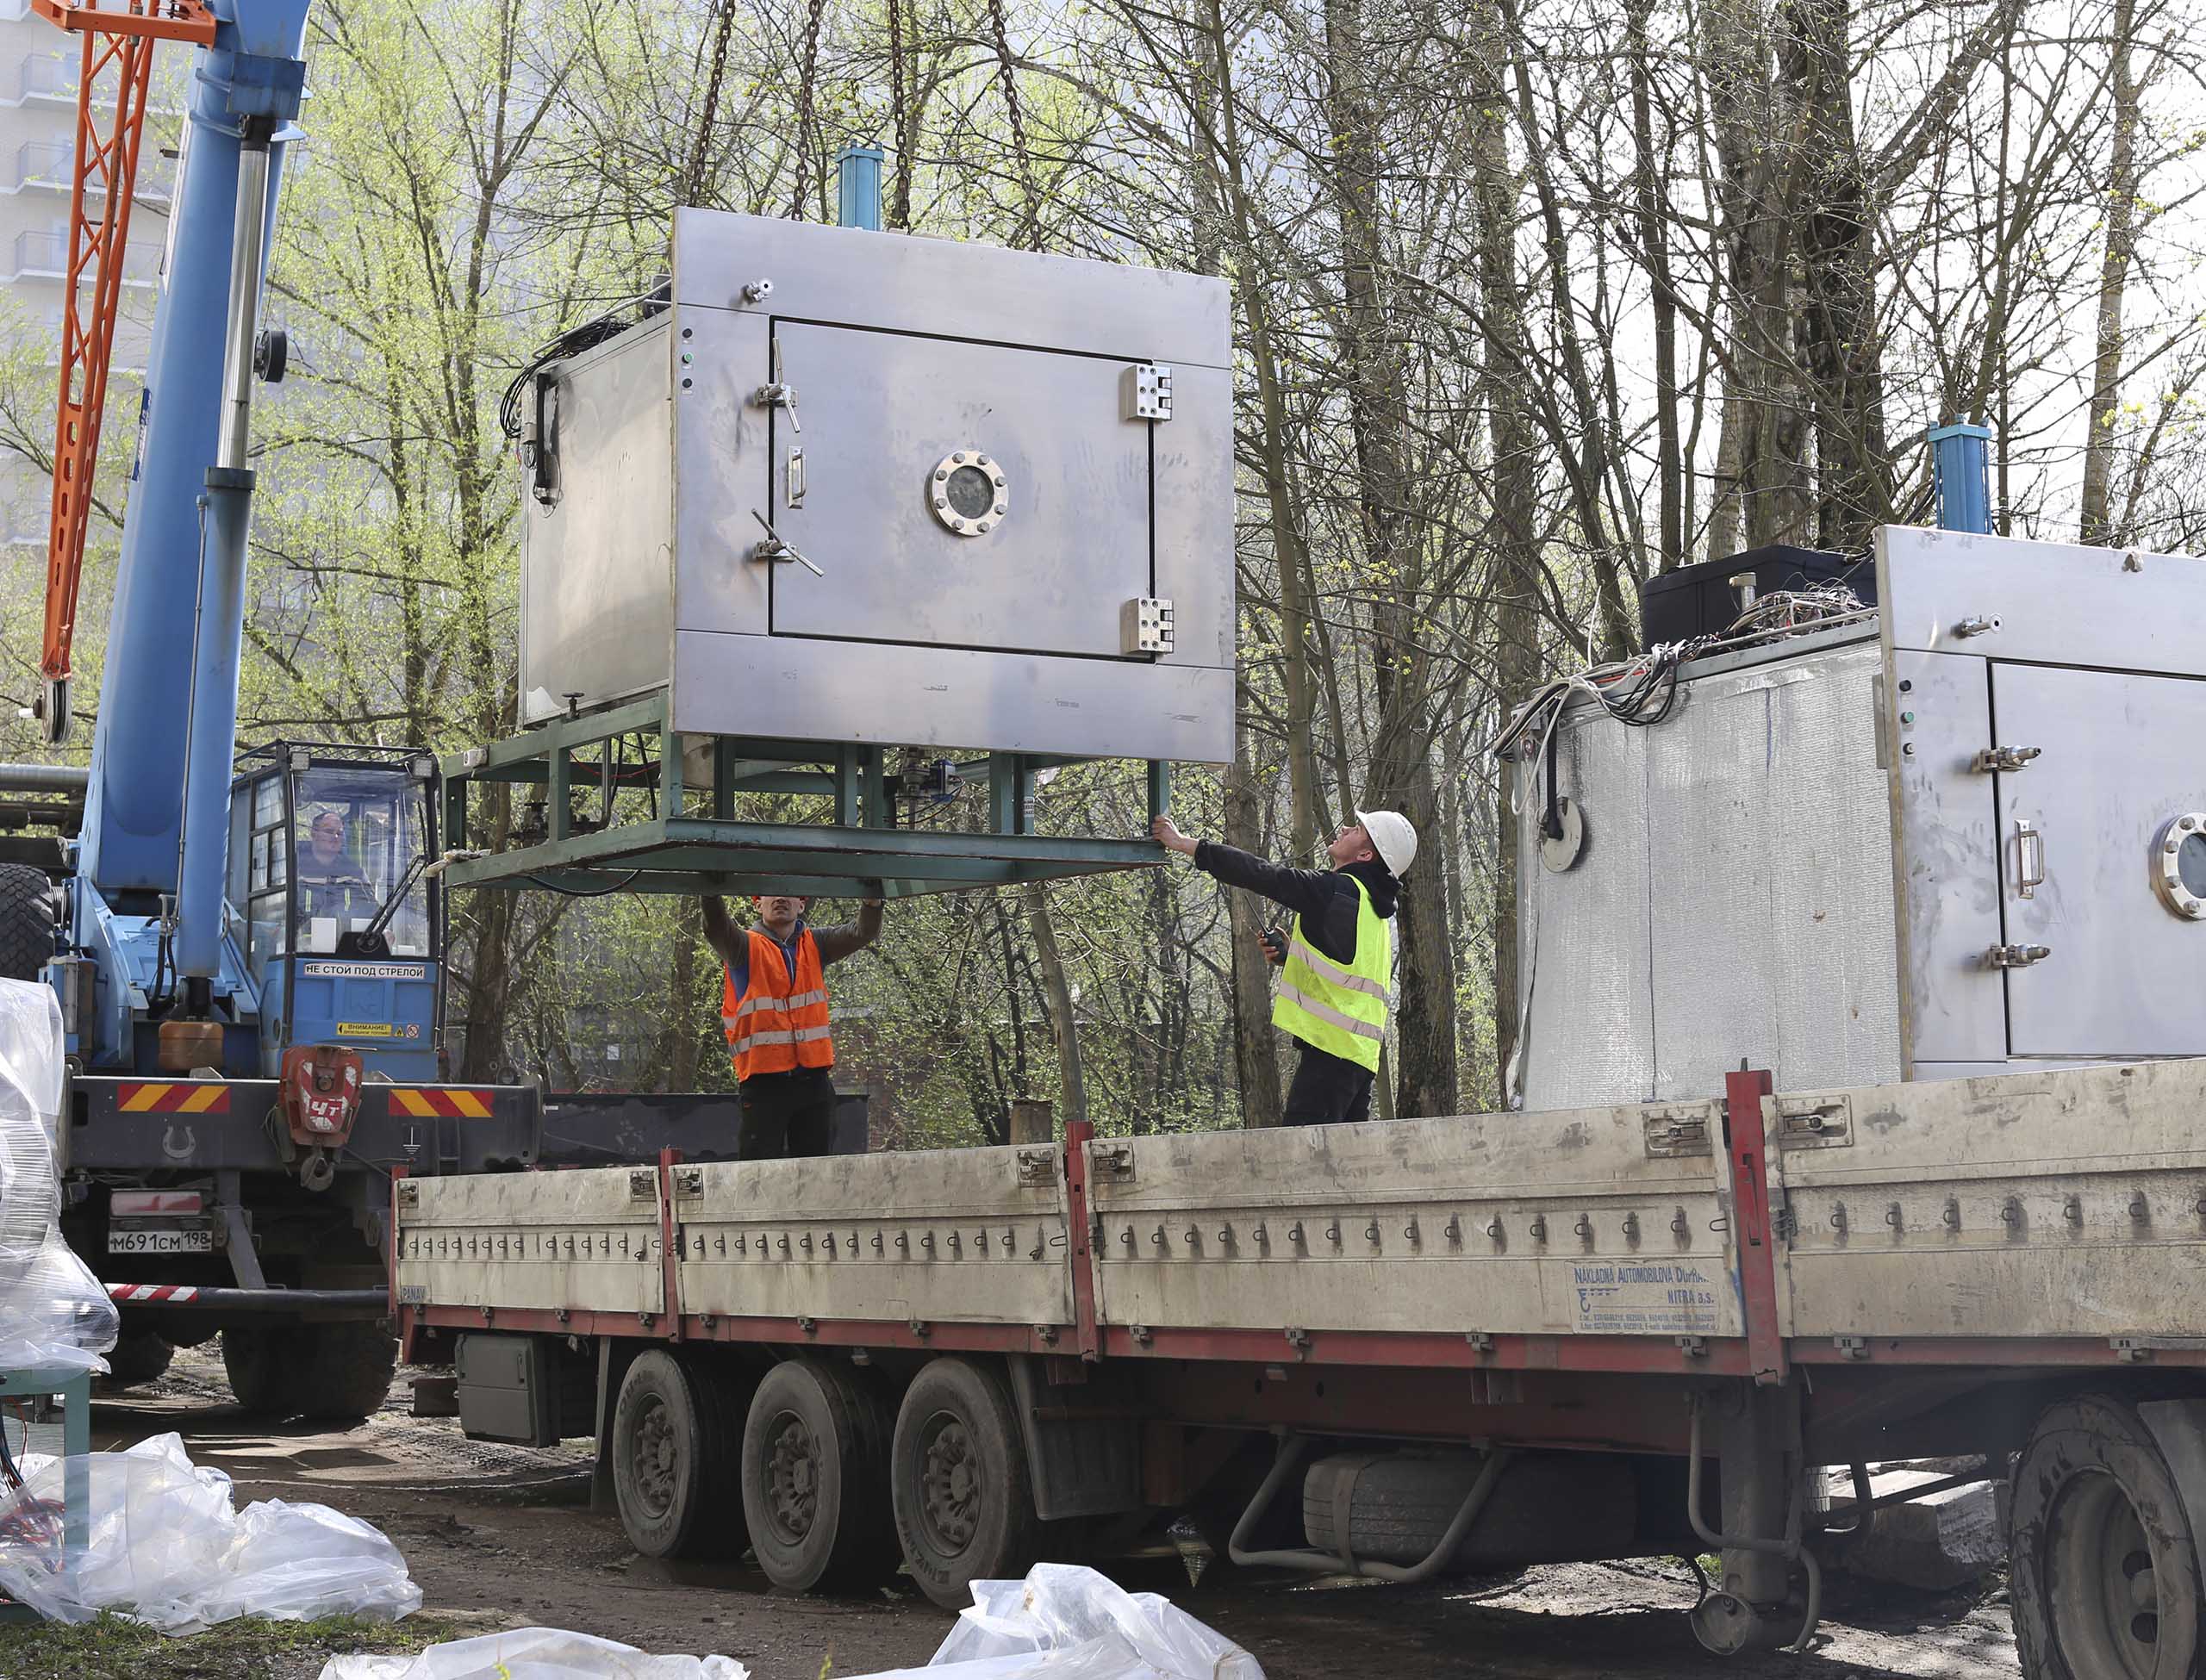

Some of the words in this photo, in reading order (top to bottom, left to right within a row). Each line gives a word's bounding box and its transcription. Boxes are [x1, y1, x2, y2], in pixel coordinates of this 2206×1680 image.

[306, 965, 320, 974] НЕ
[323, 964, 351, 975] СТОЙ
[354, 967, 376, 977] ПОД
[378, 967, 423, 978] СТРЕЛОЙ
[184, 1232, 208, 1245] 198
[1667, 1289, 1695, 1304] NITRA
[1698, 1291, 1715, 1304] a.s.
